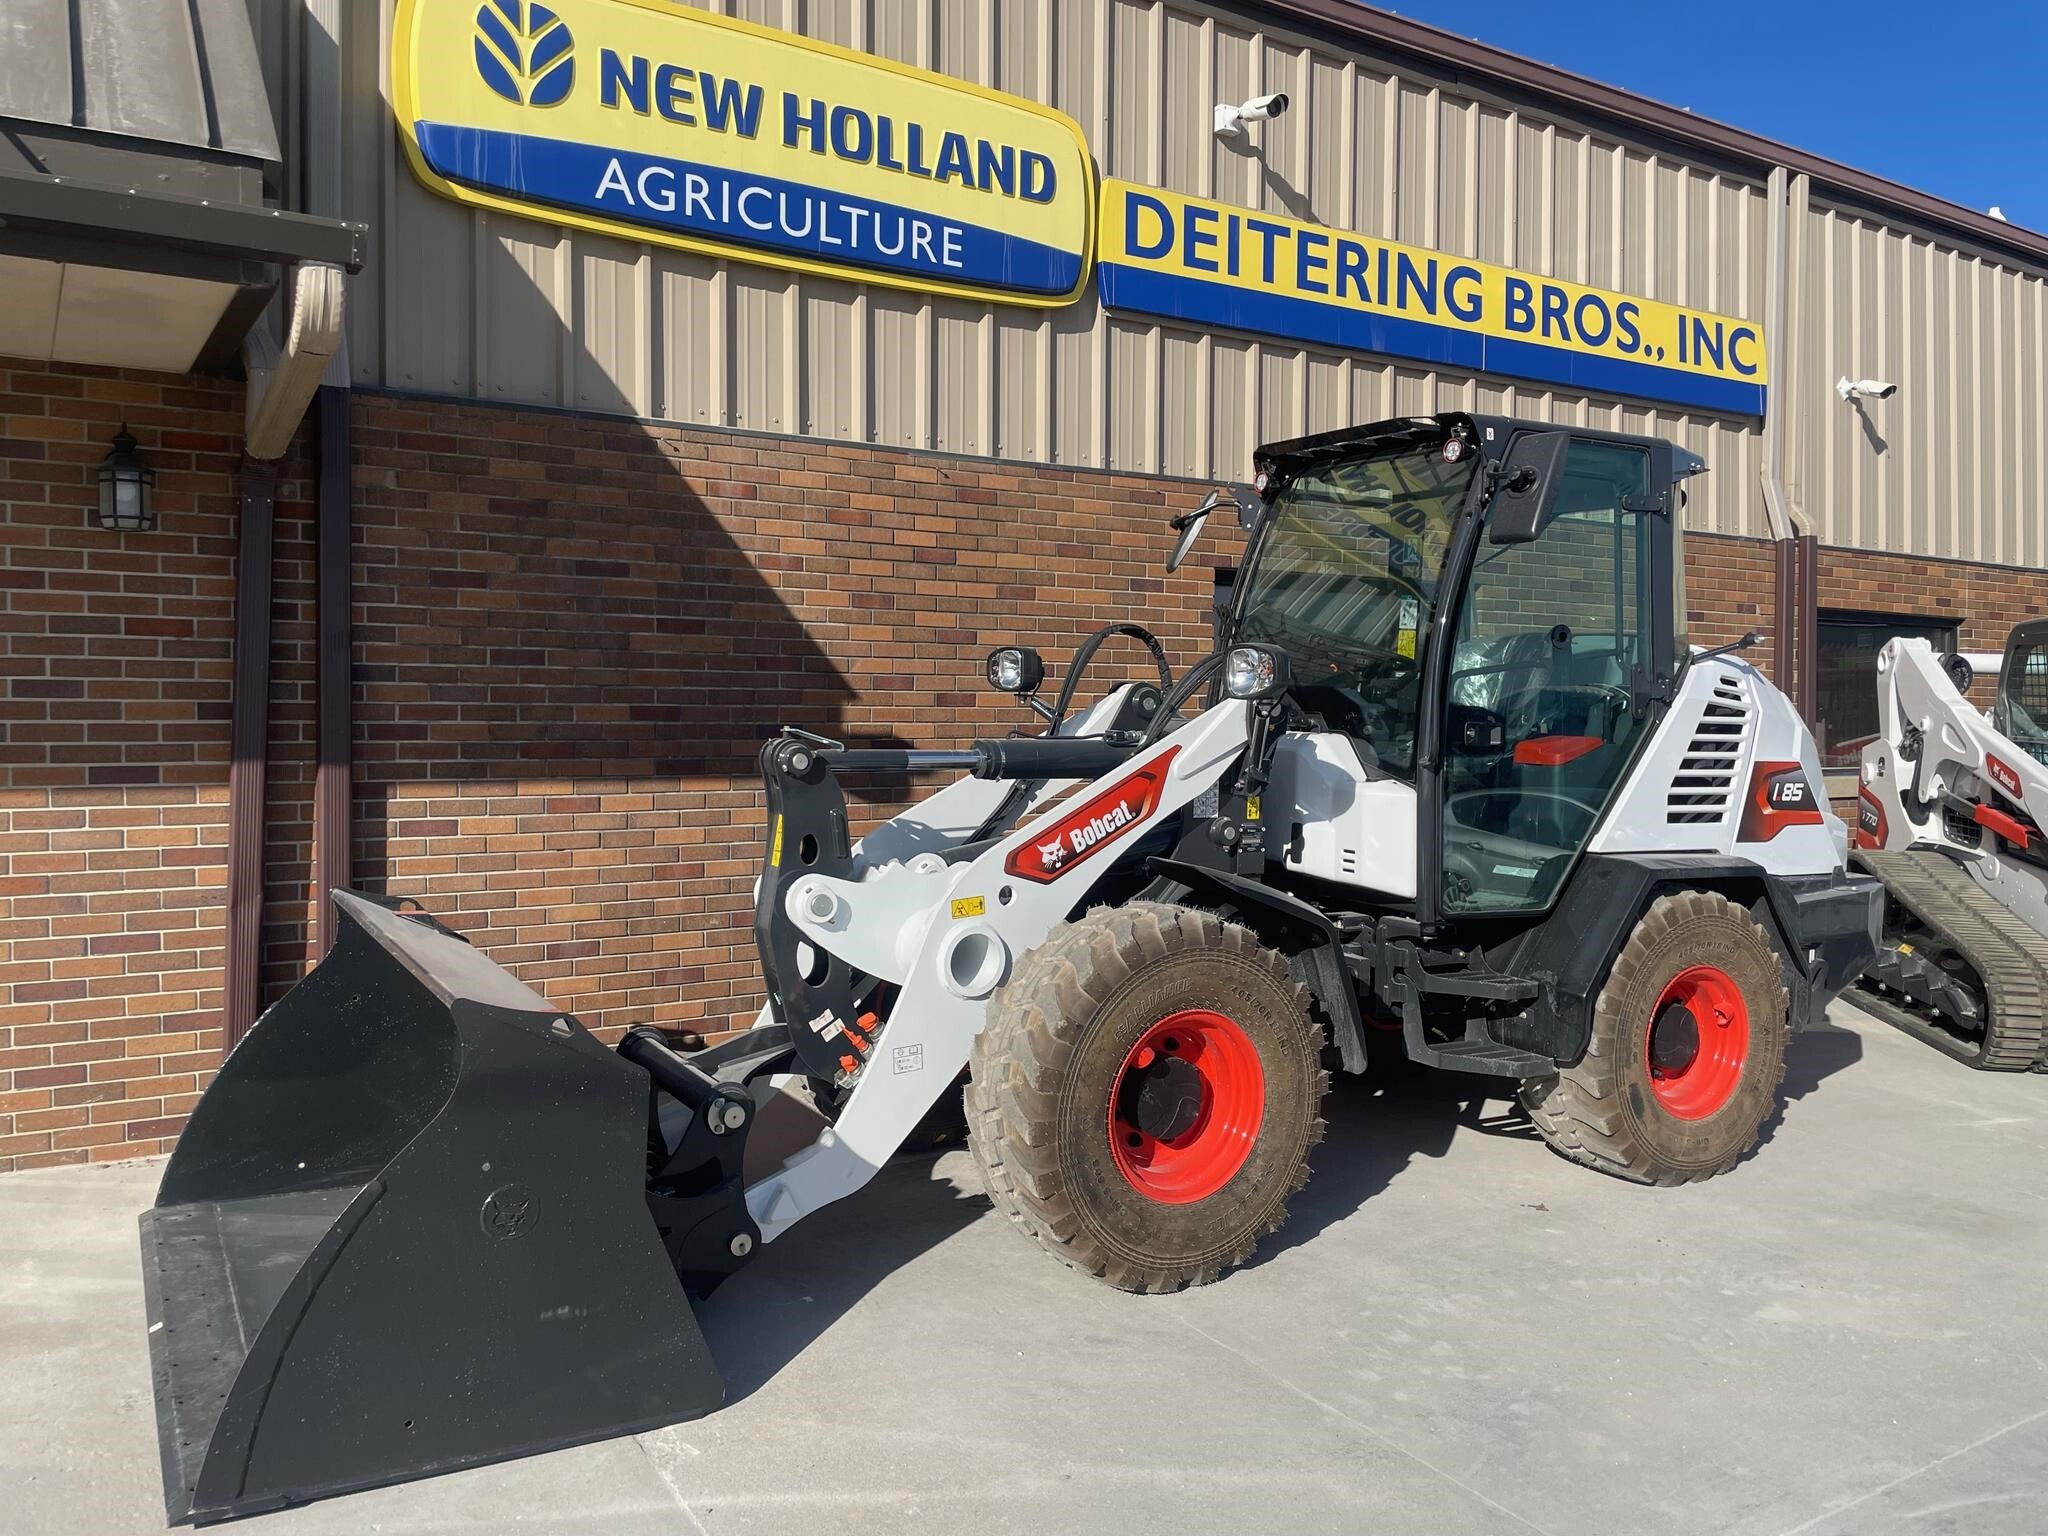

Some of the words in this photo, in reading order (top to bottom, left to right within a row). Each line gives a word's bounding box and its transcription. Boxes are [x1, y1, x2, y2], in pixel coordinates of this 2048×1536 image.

[598, 48, 764, 141] NEW
[782, 92, 1057, 205] HOLLAND
[595, 158, 963, 268] AGRICULTURE
[1125, 191, 1483, 323] DEITERING
[1505, 276, 1664, 363] BROS.,
[1678, 314, 1758, 376] INC
[1069, 800, 1132, 853] Bobcat
